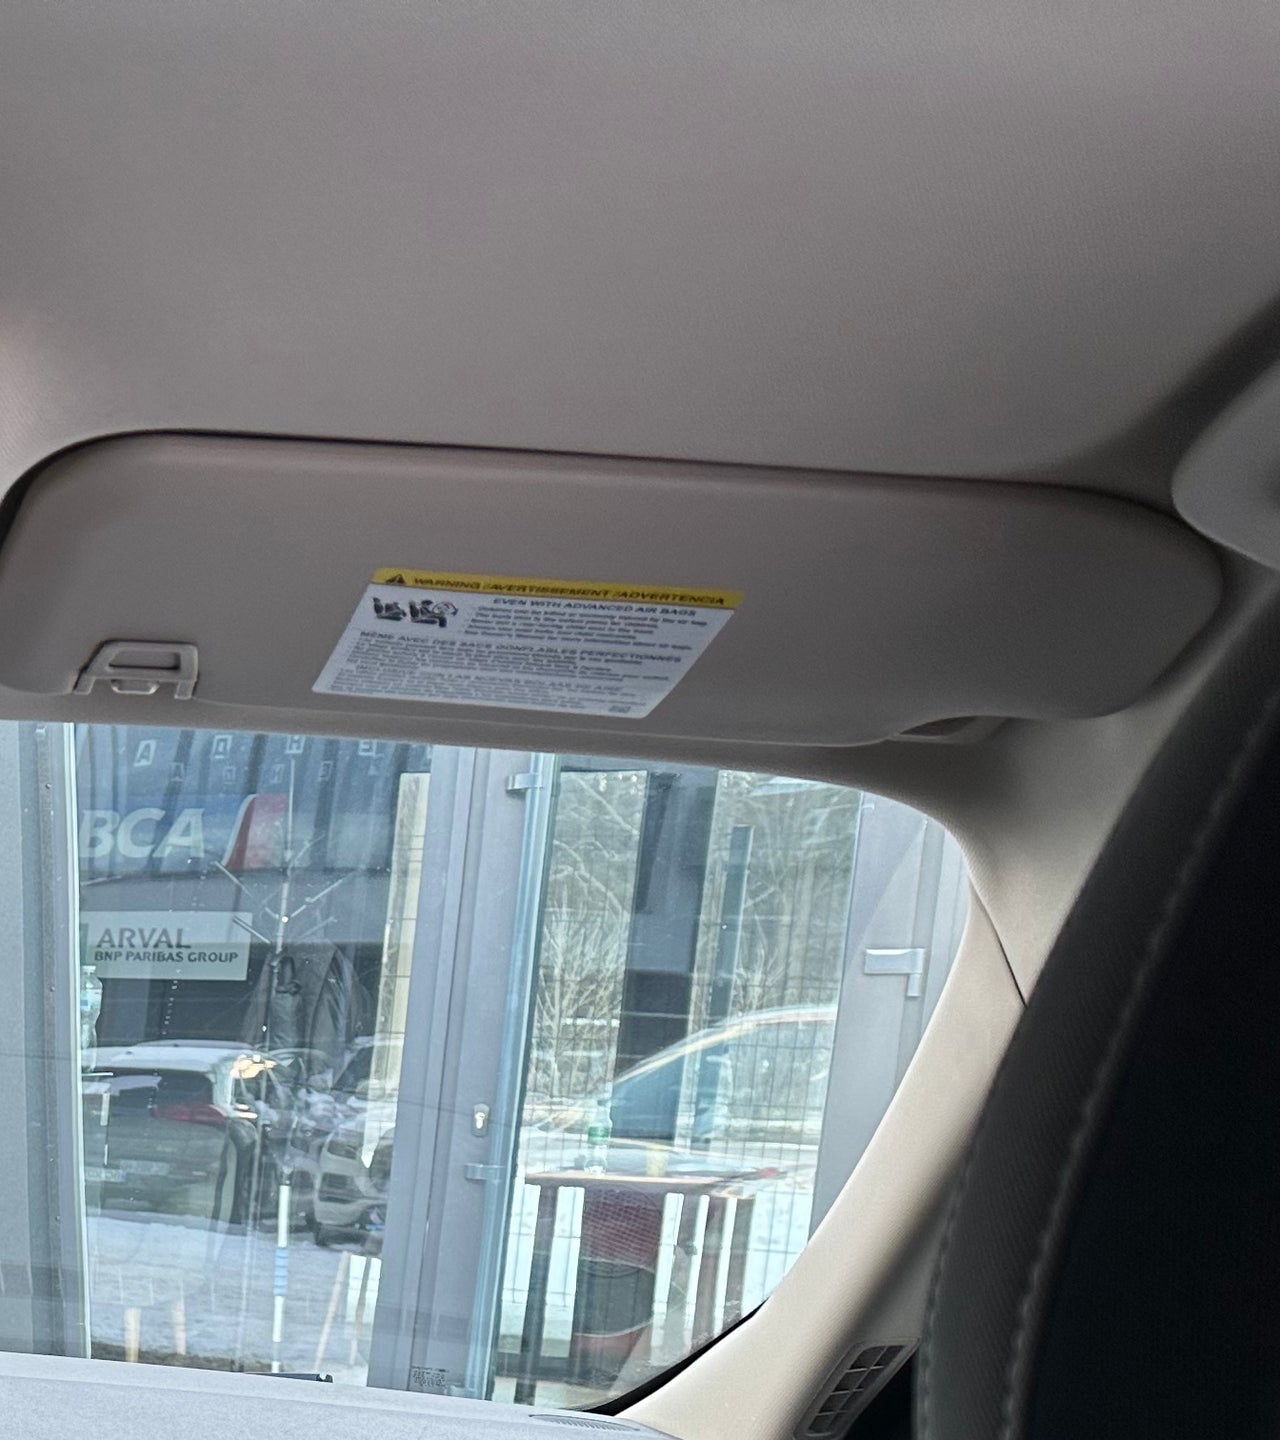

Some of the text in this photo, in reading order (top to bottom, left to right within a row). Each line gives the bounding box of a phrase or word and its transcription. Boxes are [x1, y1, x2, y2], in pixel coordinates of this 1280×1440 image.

[413, 577, 481, 590] WARNING
[78, 807, 206, 858] BCA
[96, 927, 192, 949] ARVAL
[94, 951, 239, 963] BNP PARIBAS GROUP
